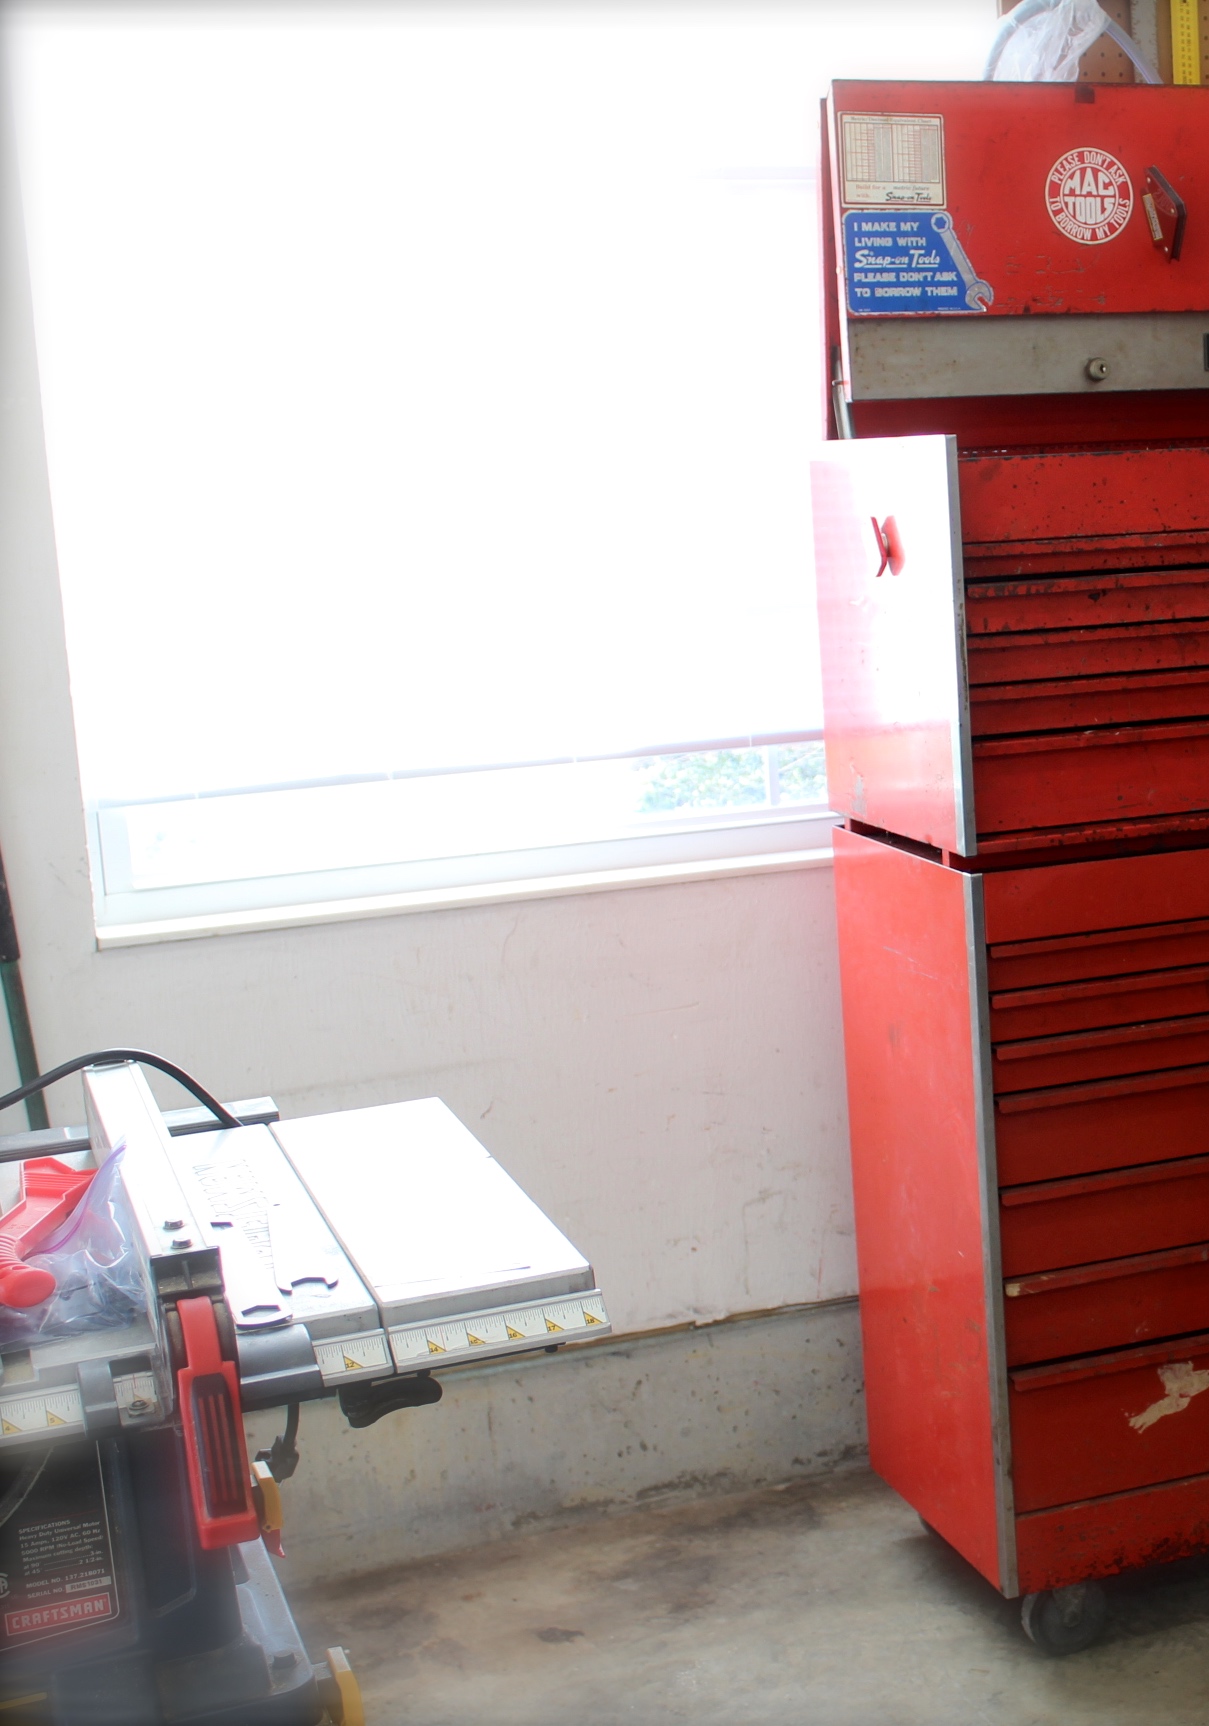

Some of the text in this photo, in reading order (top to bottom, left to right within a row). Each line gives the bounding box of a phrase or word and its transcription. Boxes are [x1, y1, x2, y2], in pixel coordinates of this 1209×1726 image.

[1051, 151, 1126, 186] PLEASE DON'T ASK
[1064, 167, 1115, 196] MAC
[1064, 196, 1115, 224] TOOLS
[1049, 196, 1062, 211] TO
[1056, 212, 1092, 240] BORROW
[1095, 224, 1111, 240] MY
[1110, 198, 1130, 228] TOOLS
[854, 222, 919, 231] I MAKE MY
[854, 237, 927, 247] LIVING WITH
[854, 249, 940, 268] Snap-on Tools
[854, 271, 957, 282] PLEASE DON'T ASK
[854, 286, 958, 297] TO BORROW THEM
[18, 1520, 70, 1534] SPECIFICATIONS
[19, 1533, 38, 1541] Heavy
[54, 1524, 81, 1534] Universal
[21, 1548, 38, 1556] 5000
[23, 1553, 52, 1562] Maximum
[53, 1549, 73, 1557] cutting
[26, 1580, 49, 1588] MODEL
[27, 1591, 51, 1599] SERIAL
[12, 1599, 104, 1629] CRAFTSMAN
